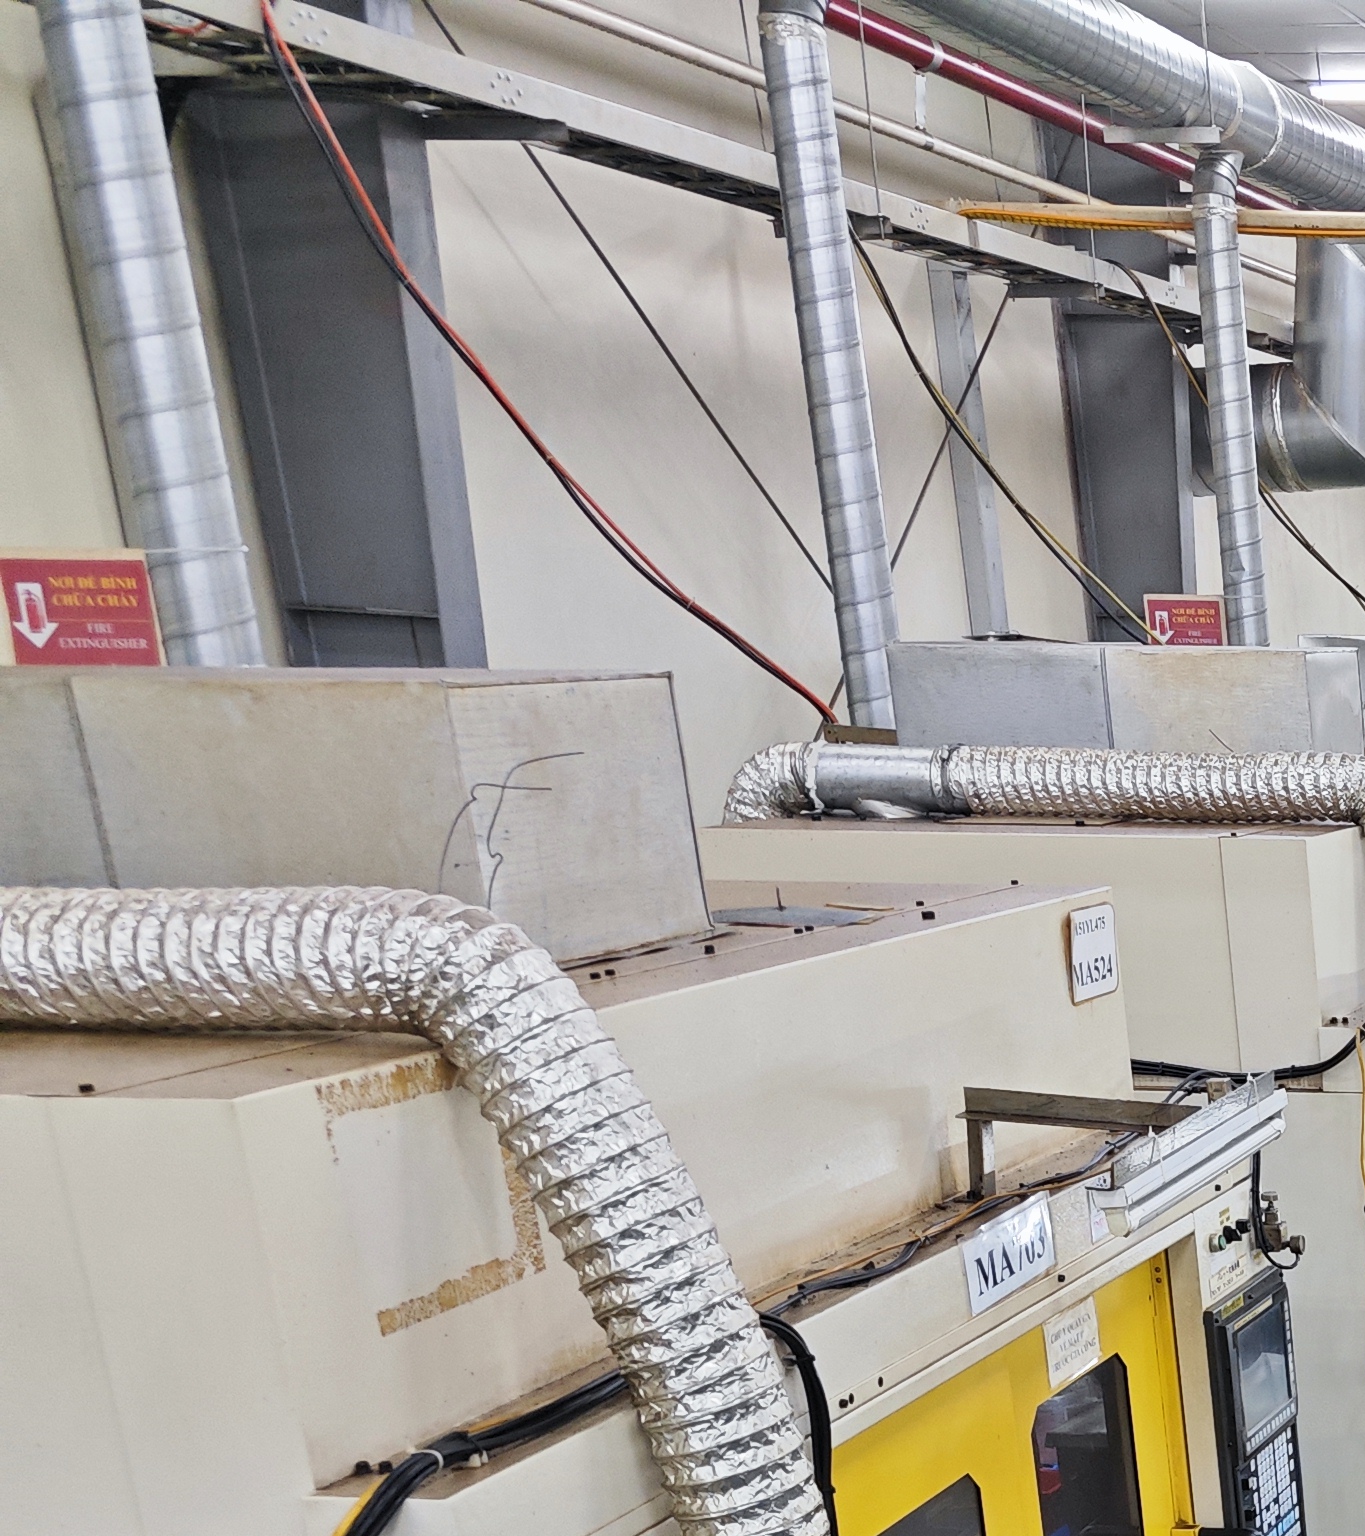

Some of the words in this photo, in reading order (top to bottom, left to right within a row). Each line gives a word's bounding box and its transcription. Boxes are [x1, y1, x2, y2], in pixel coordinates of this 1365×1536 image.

[87, 623, 115, 634] FIRE
[58, 637, 148, 649] EXTINGUISHER
[1073, 953, 1113, 987] MA524
